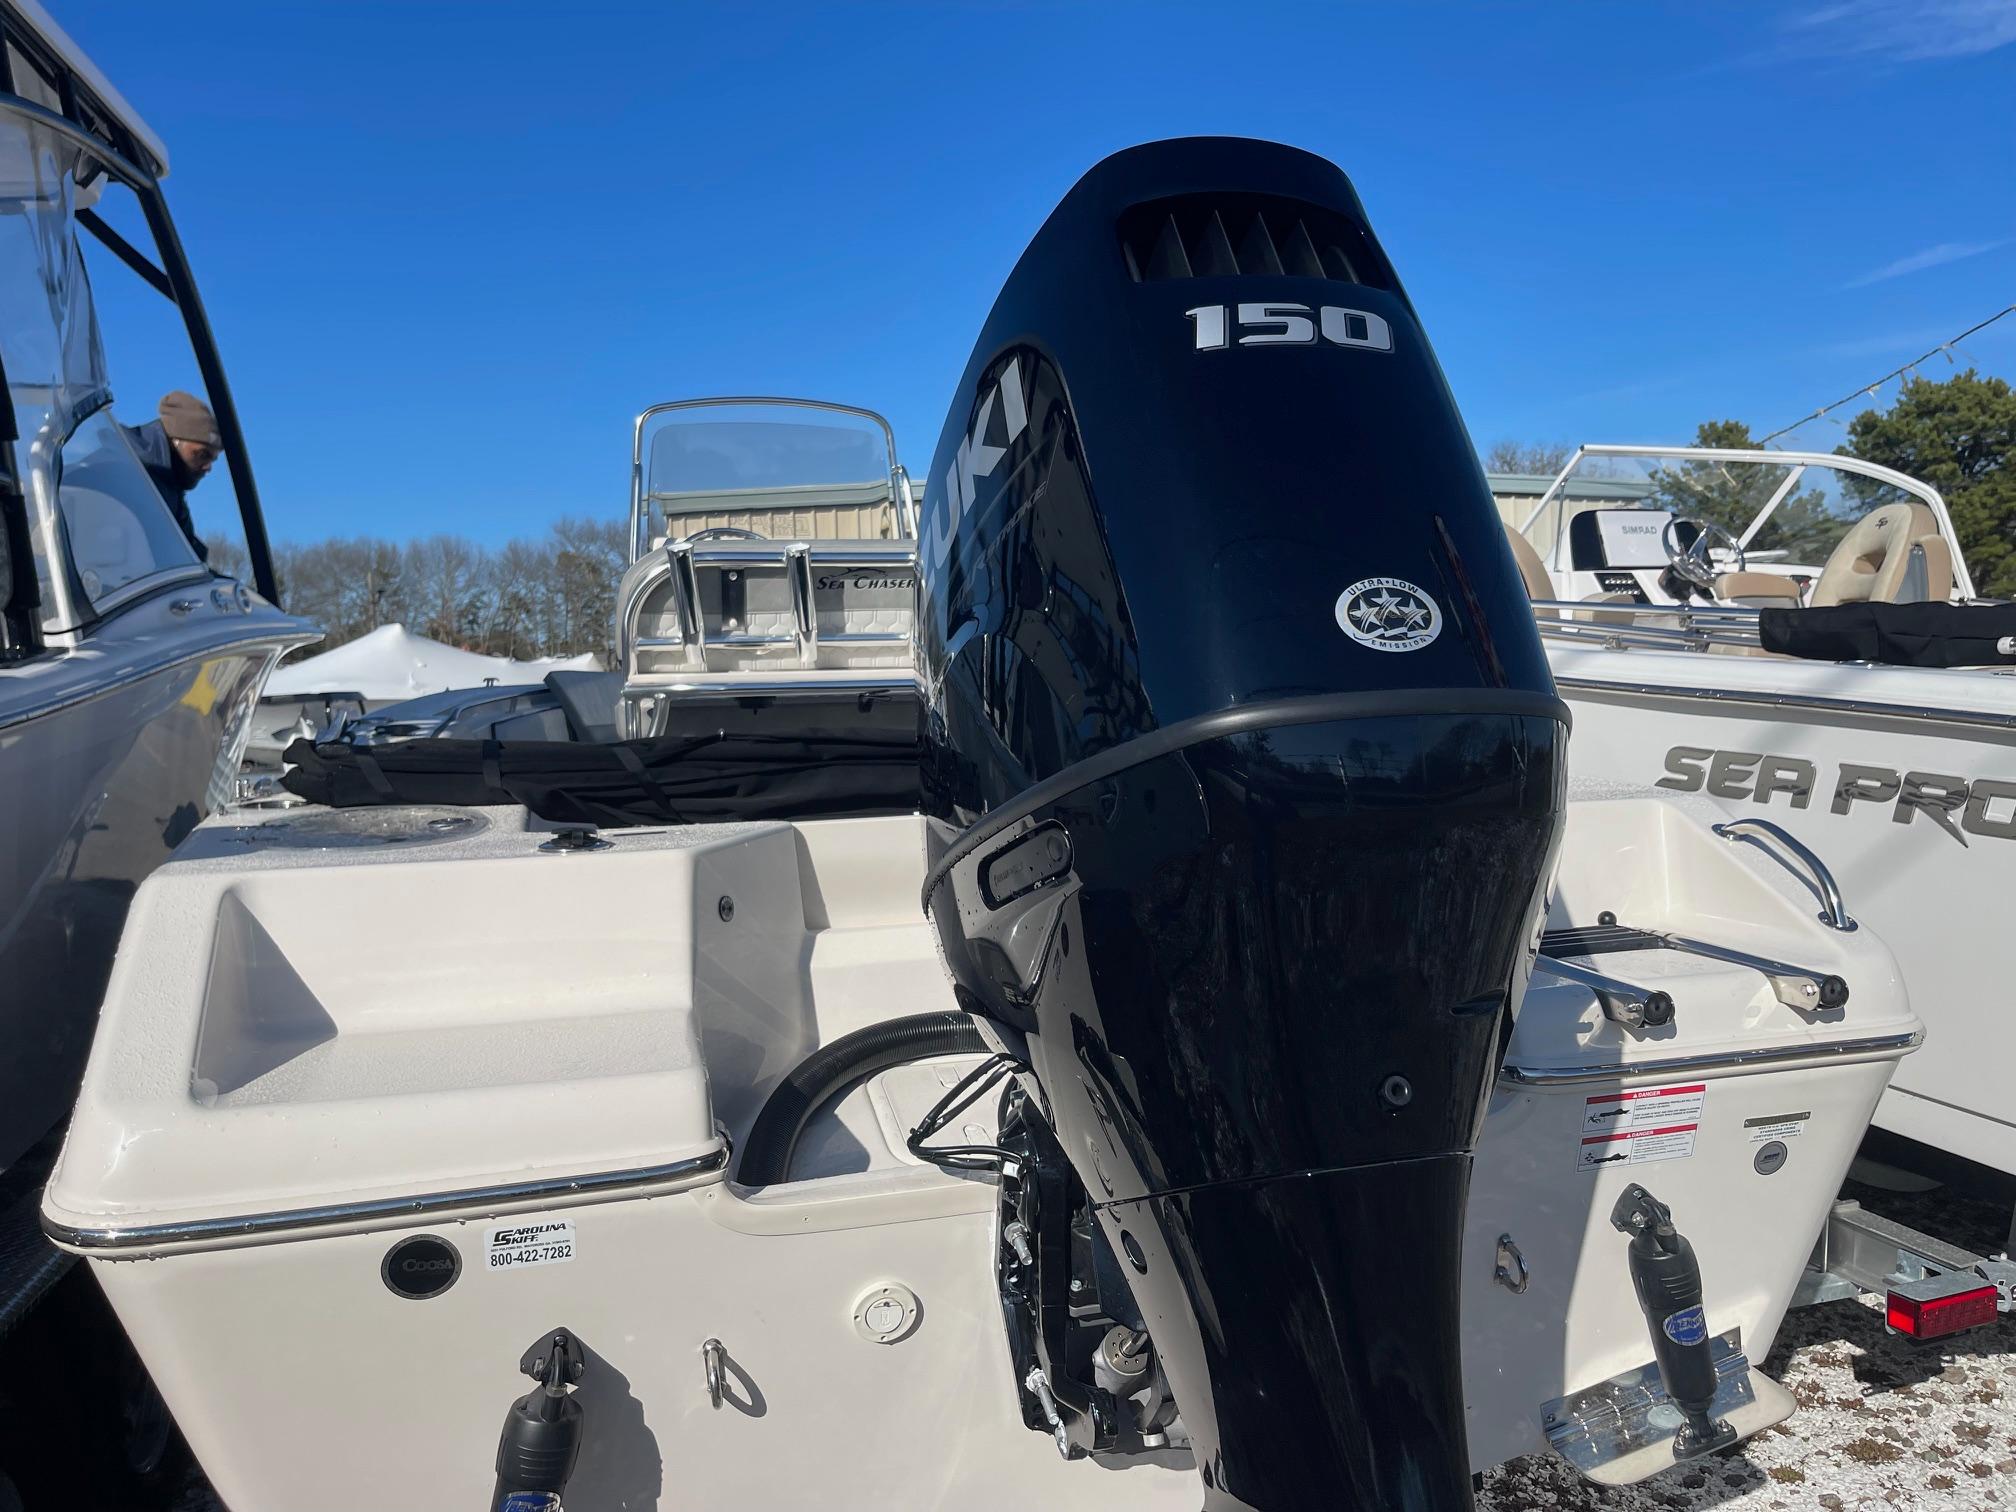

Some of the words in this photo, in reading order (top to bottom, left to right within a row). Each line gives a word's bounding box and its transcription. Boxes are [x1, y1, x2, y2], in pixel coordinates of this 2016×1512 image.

[1185, 303, 1394, 352] 150
[1621, 525, 1658, 535] SIMRAD
[817, 576, 845, 590] SEA
[1347, 578, 1384, 596] ULTRA
[1392, 579, 1418, 594] LOW
[1371, 637, 1427, 649] EMISSION
[1654, 746, 1817, 810] SEA
[1638, 1090, 1661, 1098] DANGER
[1631, 1130, 1654, 1138] DANGER
[494, 1223, 567, 1243] CAROLINA
[490, 1245, 572, 1267] 800-422-7282
